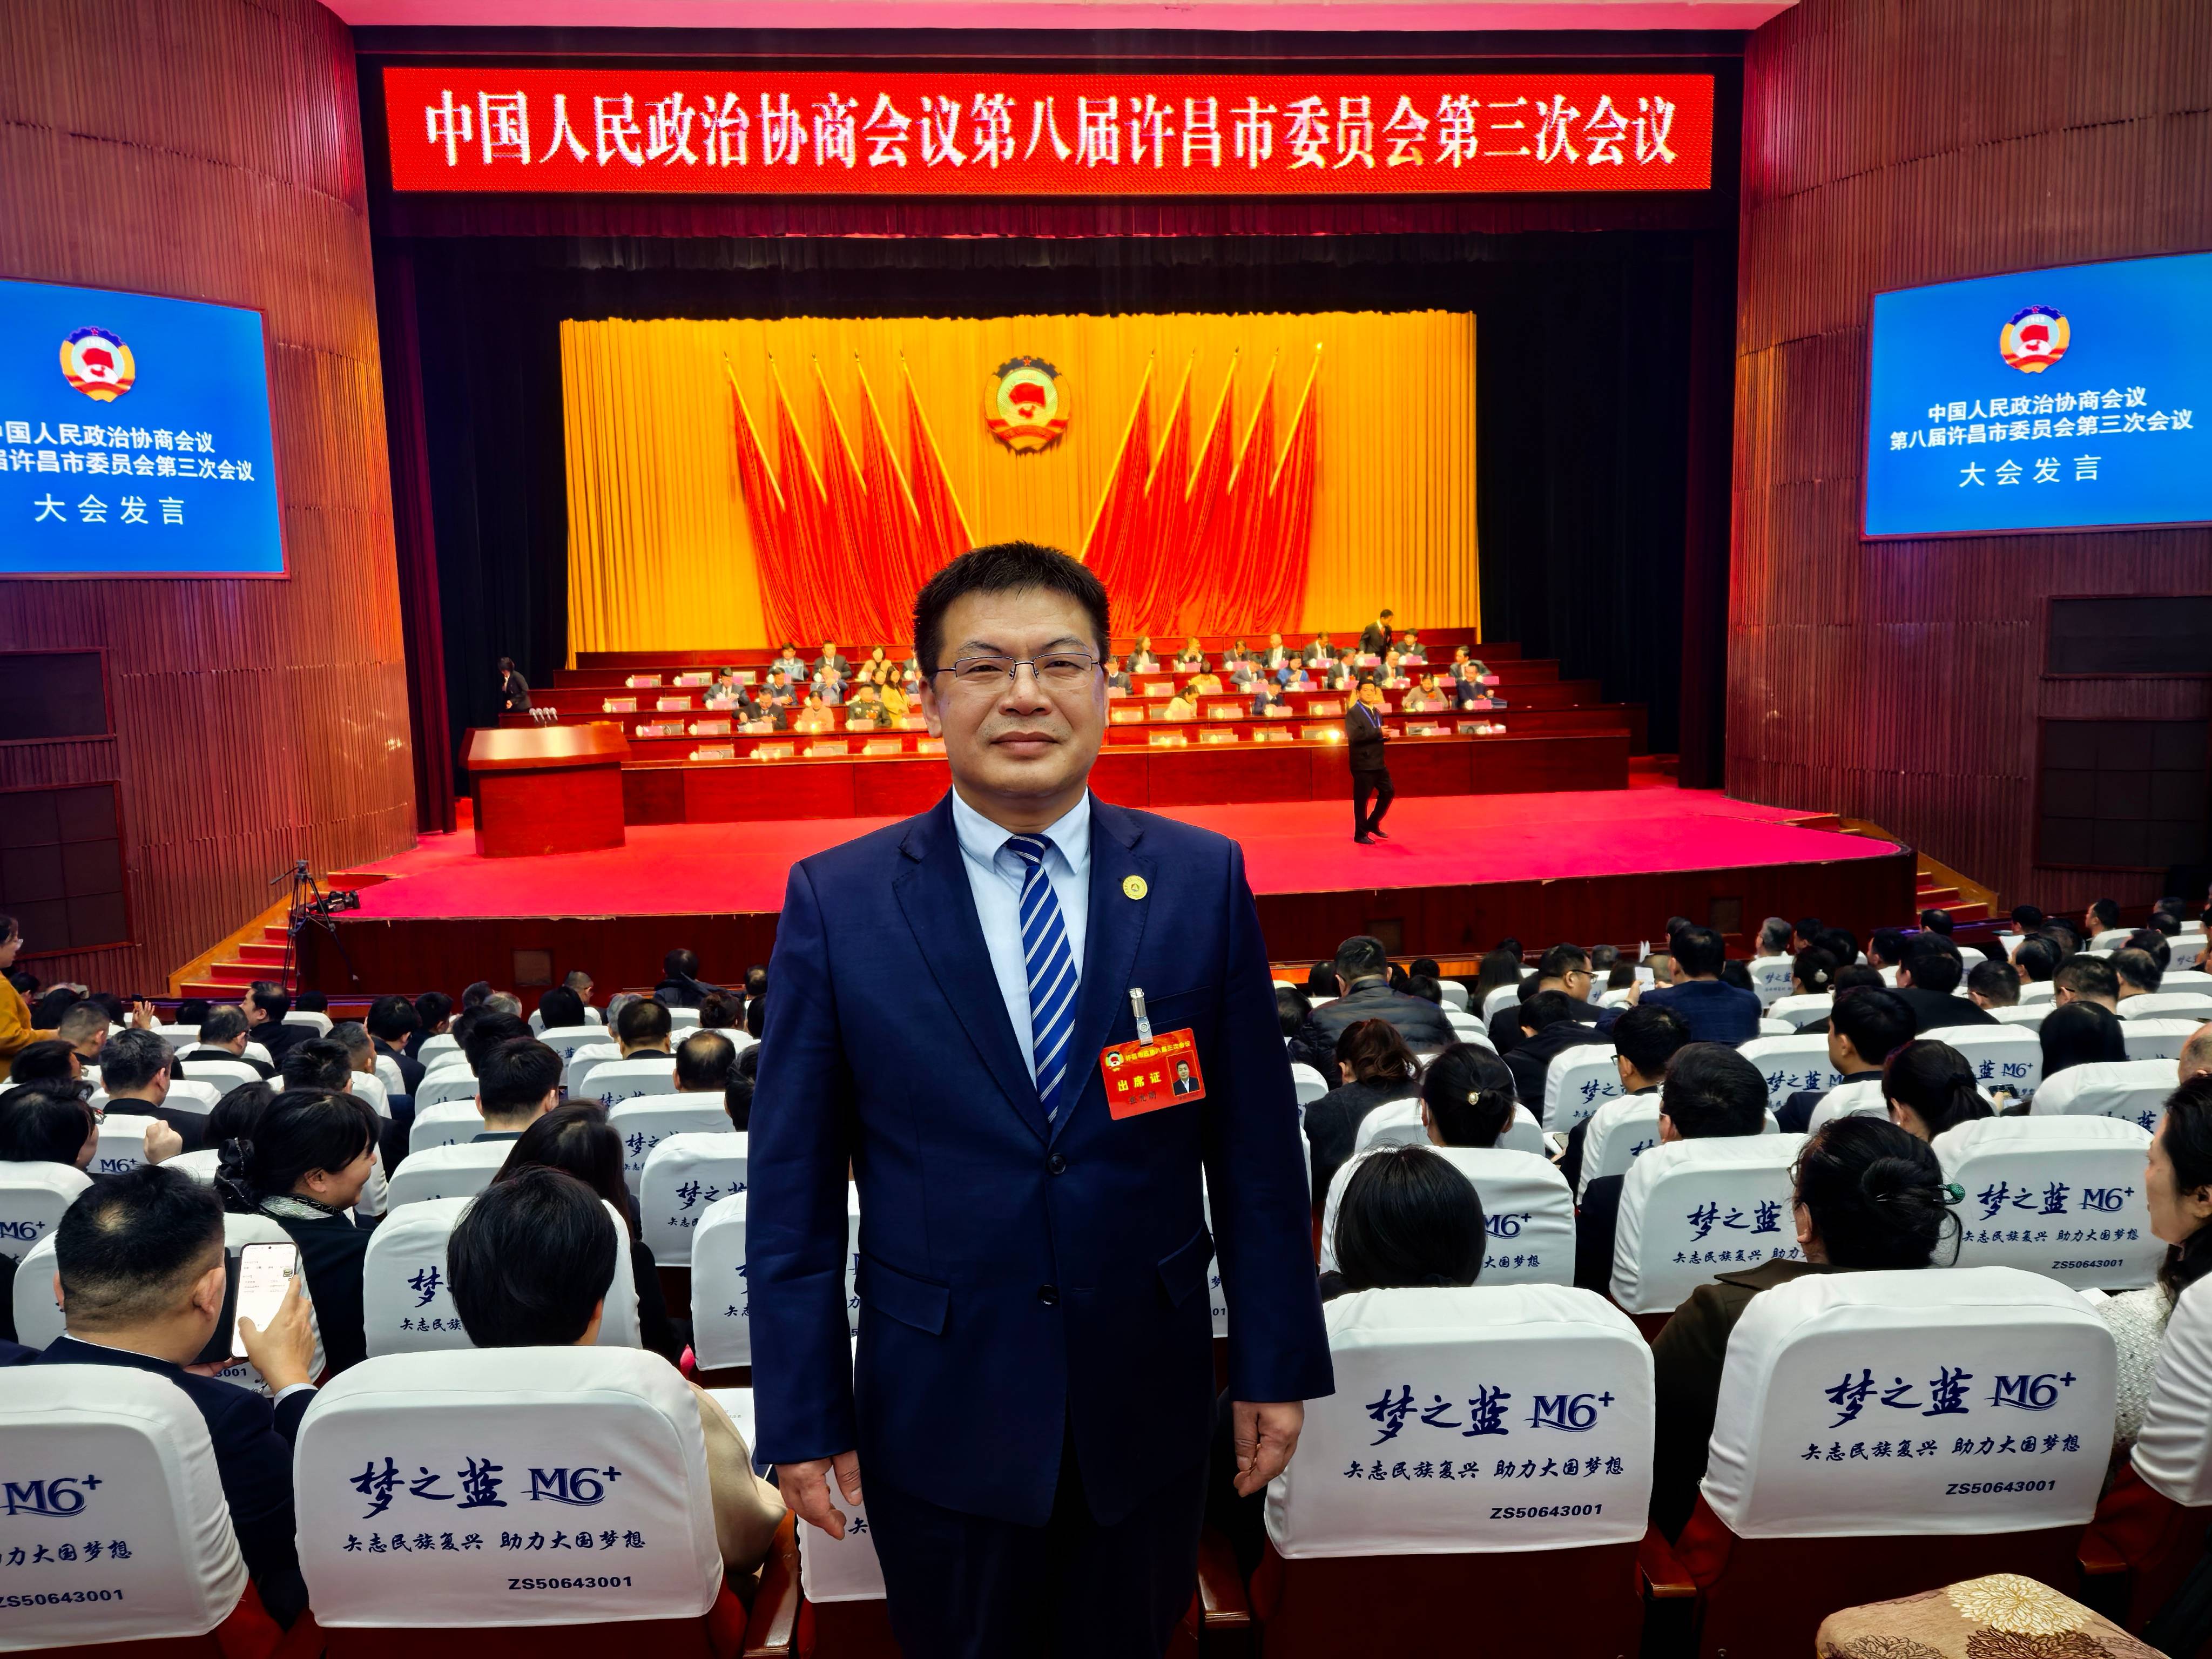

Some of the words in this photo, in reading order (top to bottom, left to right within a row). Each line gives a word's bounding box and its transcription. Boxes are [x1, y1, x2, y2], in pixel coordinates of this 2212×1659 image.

[426, 90, 1675, 168] 中国人民政治协商会议第八届许昌市委员会第三次会议
[1928, 386, 2147, 423] 中国人民政治协商会议
[0, 421, 215, 453] 国人民政治协商会议
[1890, 409, 2194, 450] 第八届许昌市委员会第三次会议
[1959, 454, 2101, 487] 大会发言
[34, 493, 184, 524] 大会发言
[1118, 1071, 1161, 1091] 出席证
[1580, 1080, 1626, 1104] 梦之
[1766, 1070, 1822, 1094] 梦之蓝
[625, 1132, 660, 1157] 梦之
[1977, 1181, 2070, 1220] 梦之蓝
[2079, 1187, 2134, 1212] M6+
[1687, 1201, 1782, 1242] 梦之蓝
[1962, 1230, 2048, 1243] 矢志民族复兴
[2056, 1229, 2139, 1242] 助力大国梦想
[1673, 1249, 1762, 1264] 矢志民族复兴
[2052, 1259, 2123, 1269] ZS50643001
[1825, 1366, 1973, 1428] 梦之蓝
[1985, 1372, 2076, 1411] M6+
[1366, 1384, 1511, 1446] 梦之蓝
[1523, 1391, 1615, 1432] M6+
[1801, 1440, 1938, 1461] 矢志民族复兴
[1952, 1434, 2080, 1455] 助力大国梦想
[1344, 1460, 1479, 1480] 矢志民族复兴
[1494, 1456, 1623, 1479] 助力大国梦想
[0, 1474, 102, 1517] M6+
[350, 1456, 507, 1519] 梦之蓝
[521, 1466, 622, 1506] M6+
[1946, 1480, 2055, 1495] ZS50643001
[1489, 1504, 1602, 1519] ZS50643001
[0, 1540, 132, 1566] 力大国梦想
[343, 1532, 483, 1553] 矢志民族复兴
[500, 1530, 645, 1550] 助力大国梦想
[508, 1576, 631, 1589] ZS50643001
